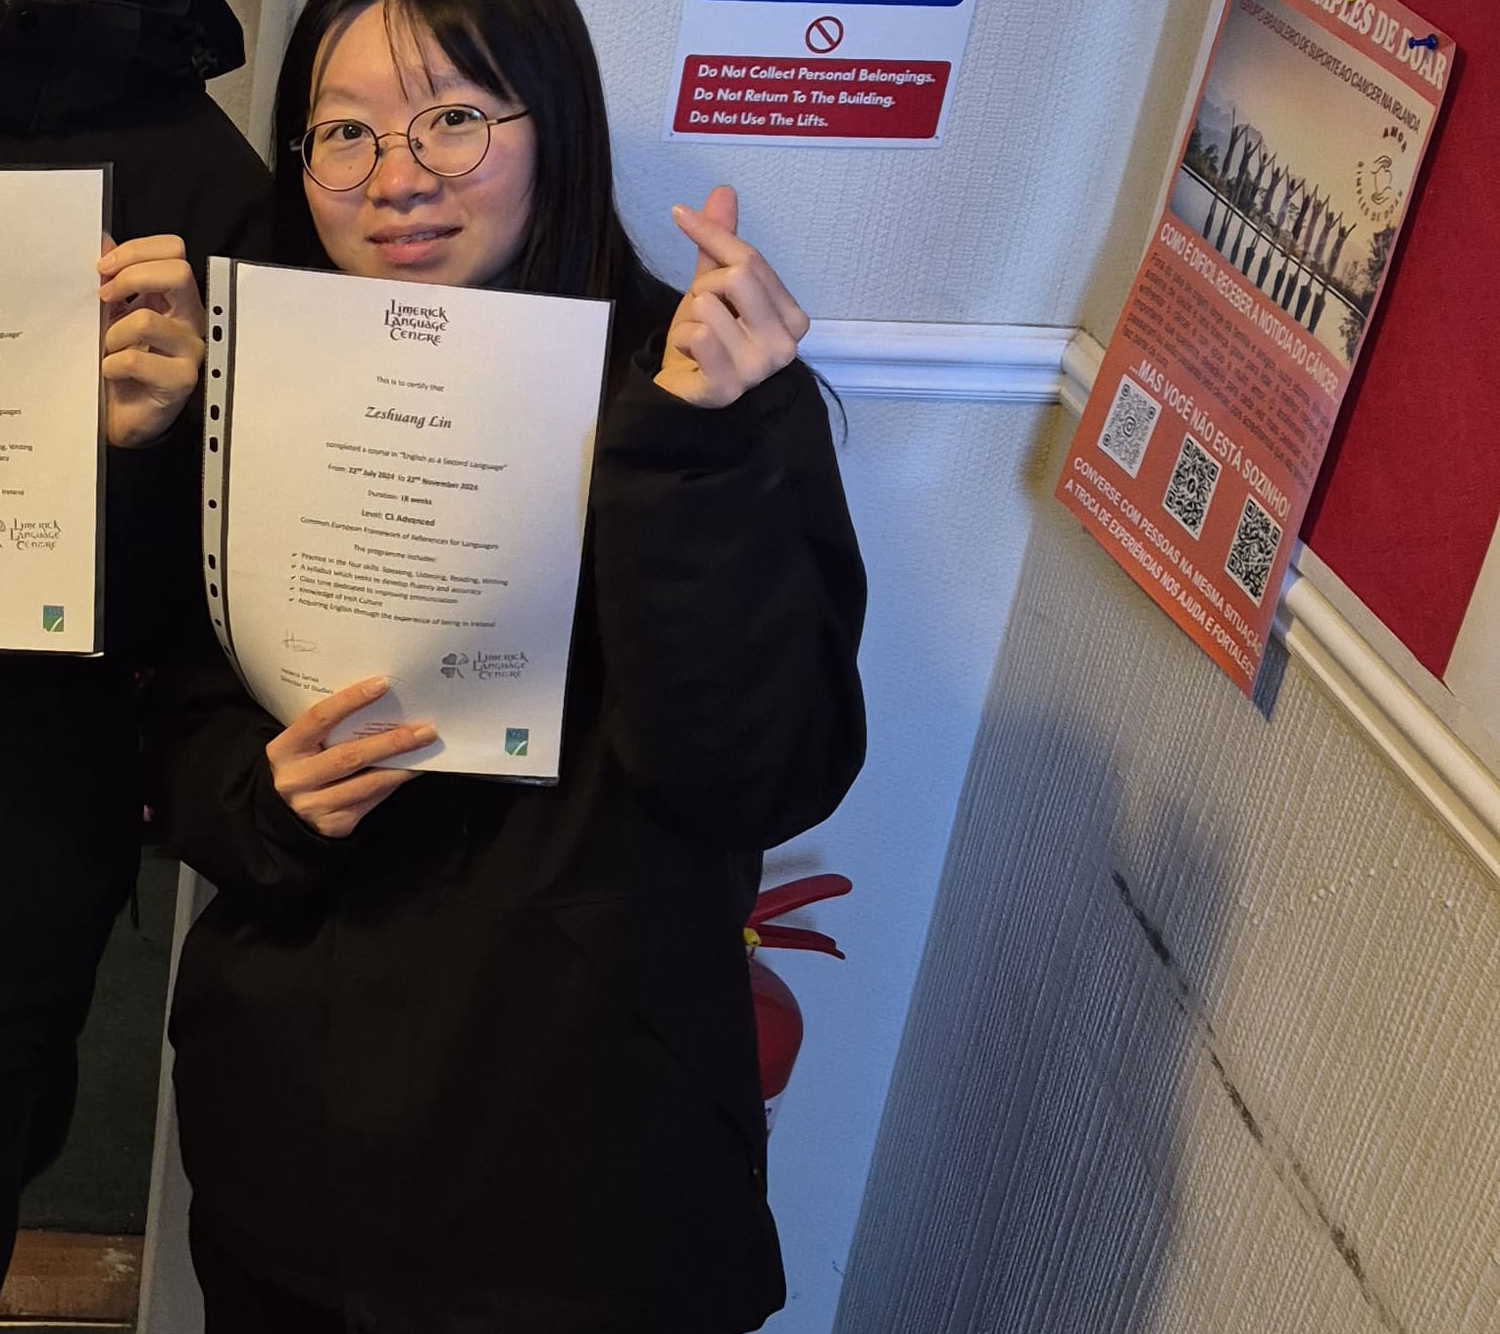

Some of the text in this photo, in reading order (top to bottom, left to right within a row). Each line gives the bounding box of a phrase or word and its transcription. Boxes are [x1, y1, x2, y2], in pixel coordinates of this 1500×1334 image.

[1372, 10, 1399, 54] DE
[698, 64, 936, 85] Do Not Collect Personal Belongings.
[689, 110, 829, 127] Do Not Use The Lifts.
[693, 87, 896, 108] Do Not Return To The Building.
[1161, 222, 1186, 256] COMO
[1292, 339, 1307, 365] DO
[364, 406, 452, 429] Zeshuang Lin
[1164, 380, 1194, 420] VOCÊ
[1190, 409, 1215, 444] NÃO
[1212, 425, 1244, 471] ESTÁ
[1242, 458, 1292, 521] SOZINHO!
[1074, 457, 1122, 505] CONVERSE
[1119, 499, 1142, 523] COM
[1139, 517, 1181, 564] PESSOAS
[1178, 554, 1193, 579] NA
[1190, 568, 1225, 613] MESMA
[1064, 478, 1074, 492] A
[1073, 485, 1101, 516] TROCA
[1099, 508, 1111, 527] DE
[1159, 572, 1181, 597] NOS
[1177, 590, 1206, 627] AJUDA
[1204, 616, 1214, 631] E
[1211, 623, 1255, 681] FORTALECE
